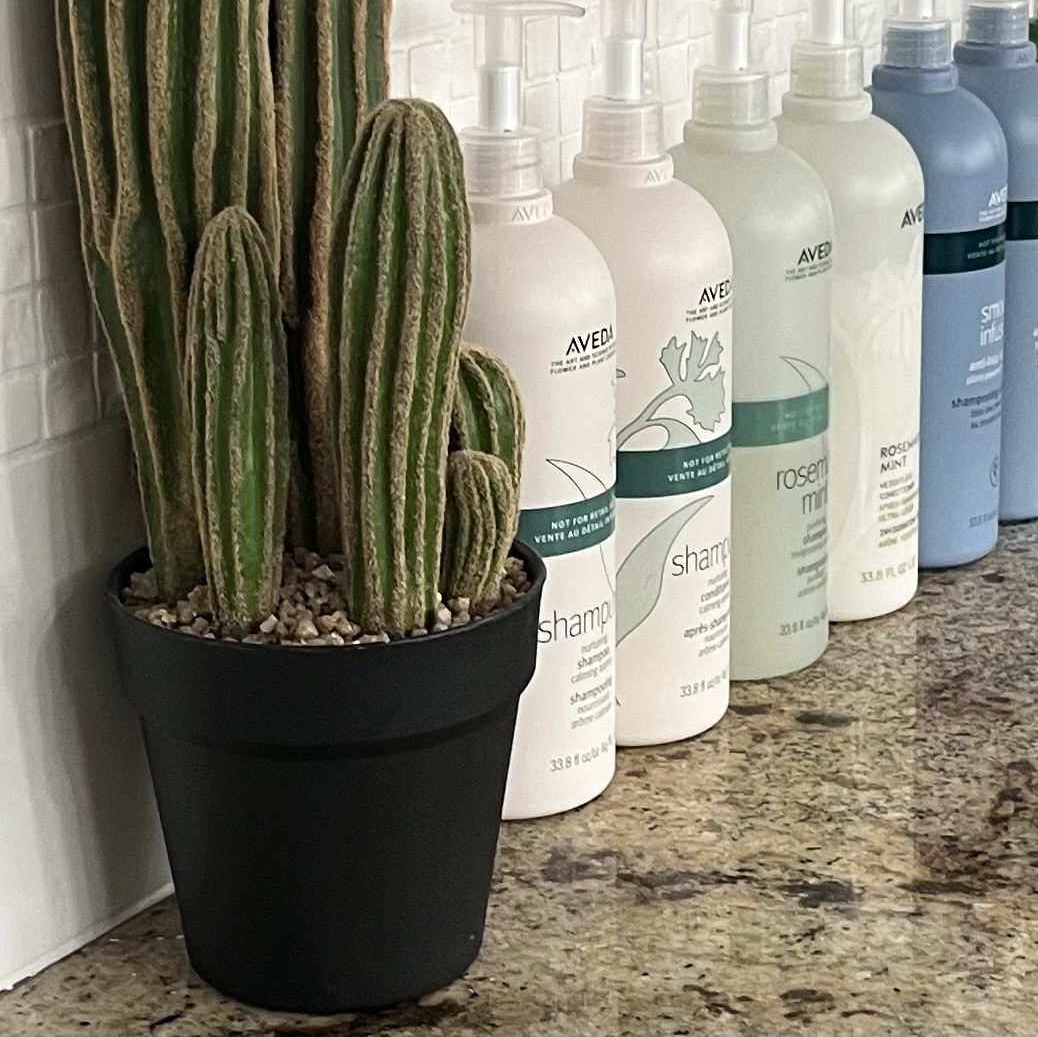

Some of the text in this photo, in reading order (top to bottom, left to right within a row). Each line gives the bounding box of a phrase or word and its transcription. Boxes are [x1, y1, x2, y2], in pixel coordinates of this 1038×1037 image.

[682, 458, 700, 469] NOT
[879, 455, 907, 474] MINT
[667, 470, 695, 482] VENTE
[551, 518, 570, 530] NOT
[572, 514, 589, 527] FOR
[534, 531, 565, 544] VENTE
[567, 528, 580, 539] AU
[550, 755, 572, 772] 33.8
